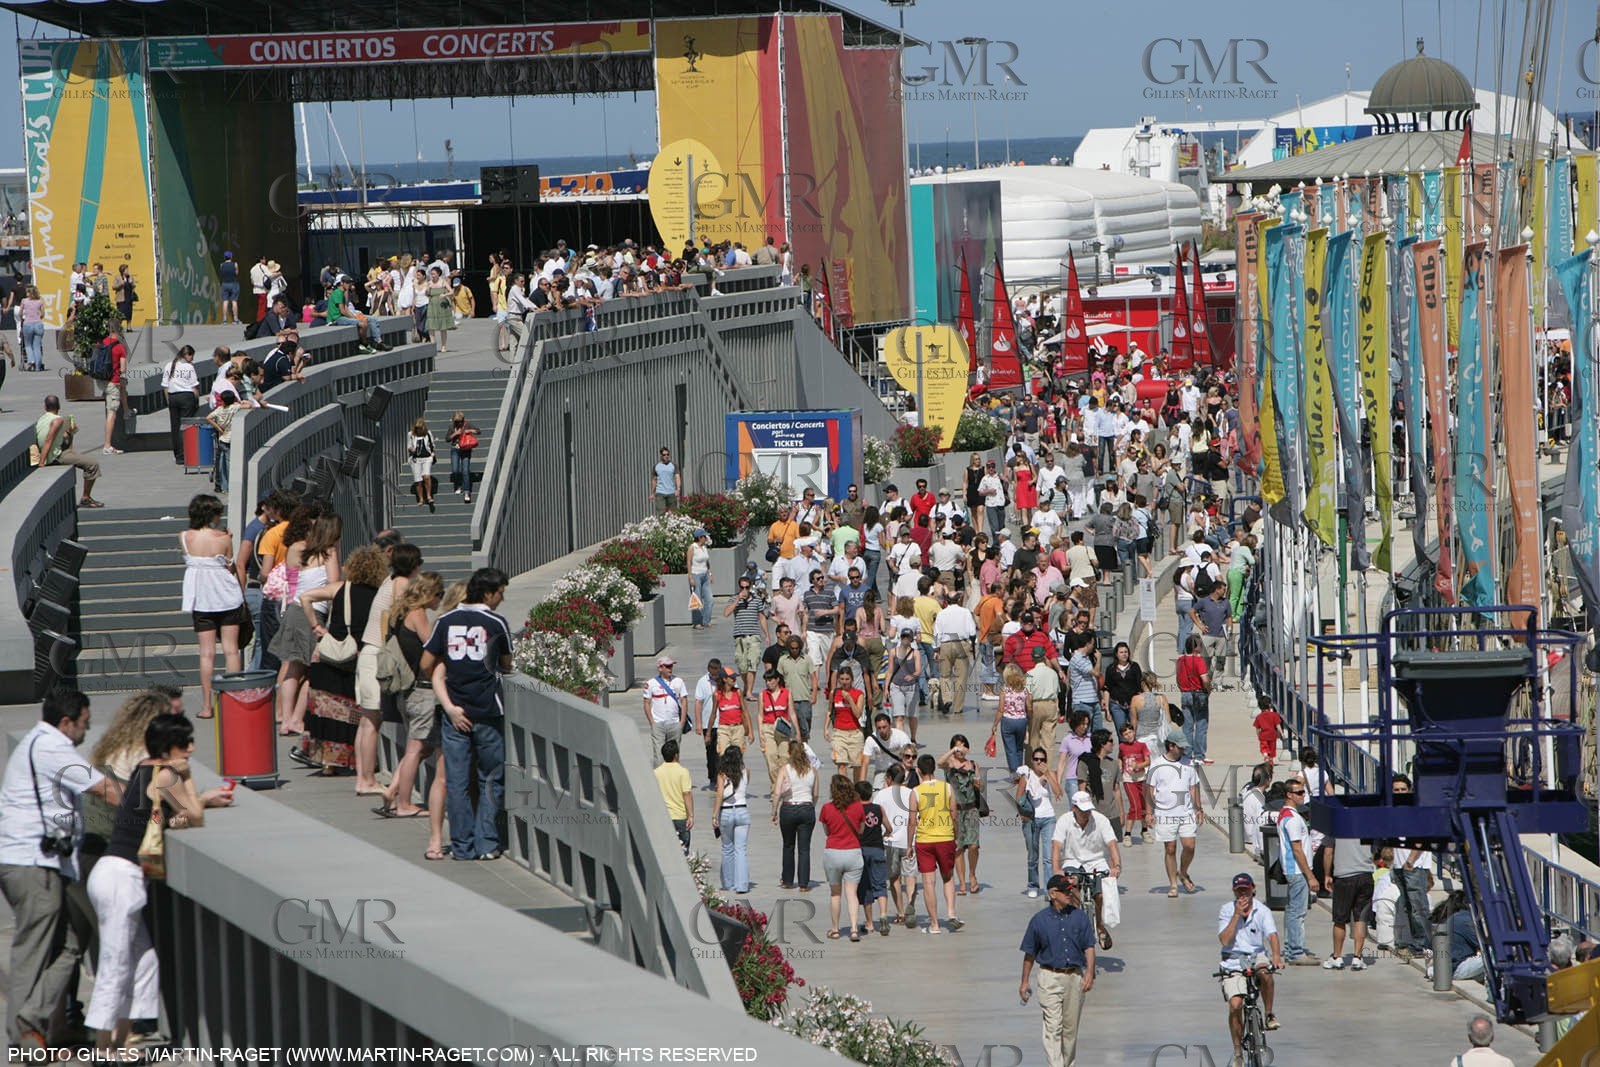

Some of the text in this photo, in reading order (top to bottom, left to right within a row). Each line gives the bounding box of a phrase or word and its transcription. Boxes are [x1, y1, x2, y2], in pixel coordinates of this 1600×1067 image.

[249, 37, 396, 62] CONCIERTOS
[422, 30, 555, 56] CONCERTS
[752, 421, 790, 430] Conciertos
[795, 420, 825, 429] Concerts
[447, 625, 488, 661] 53
